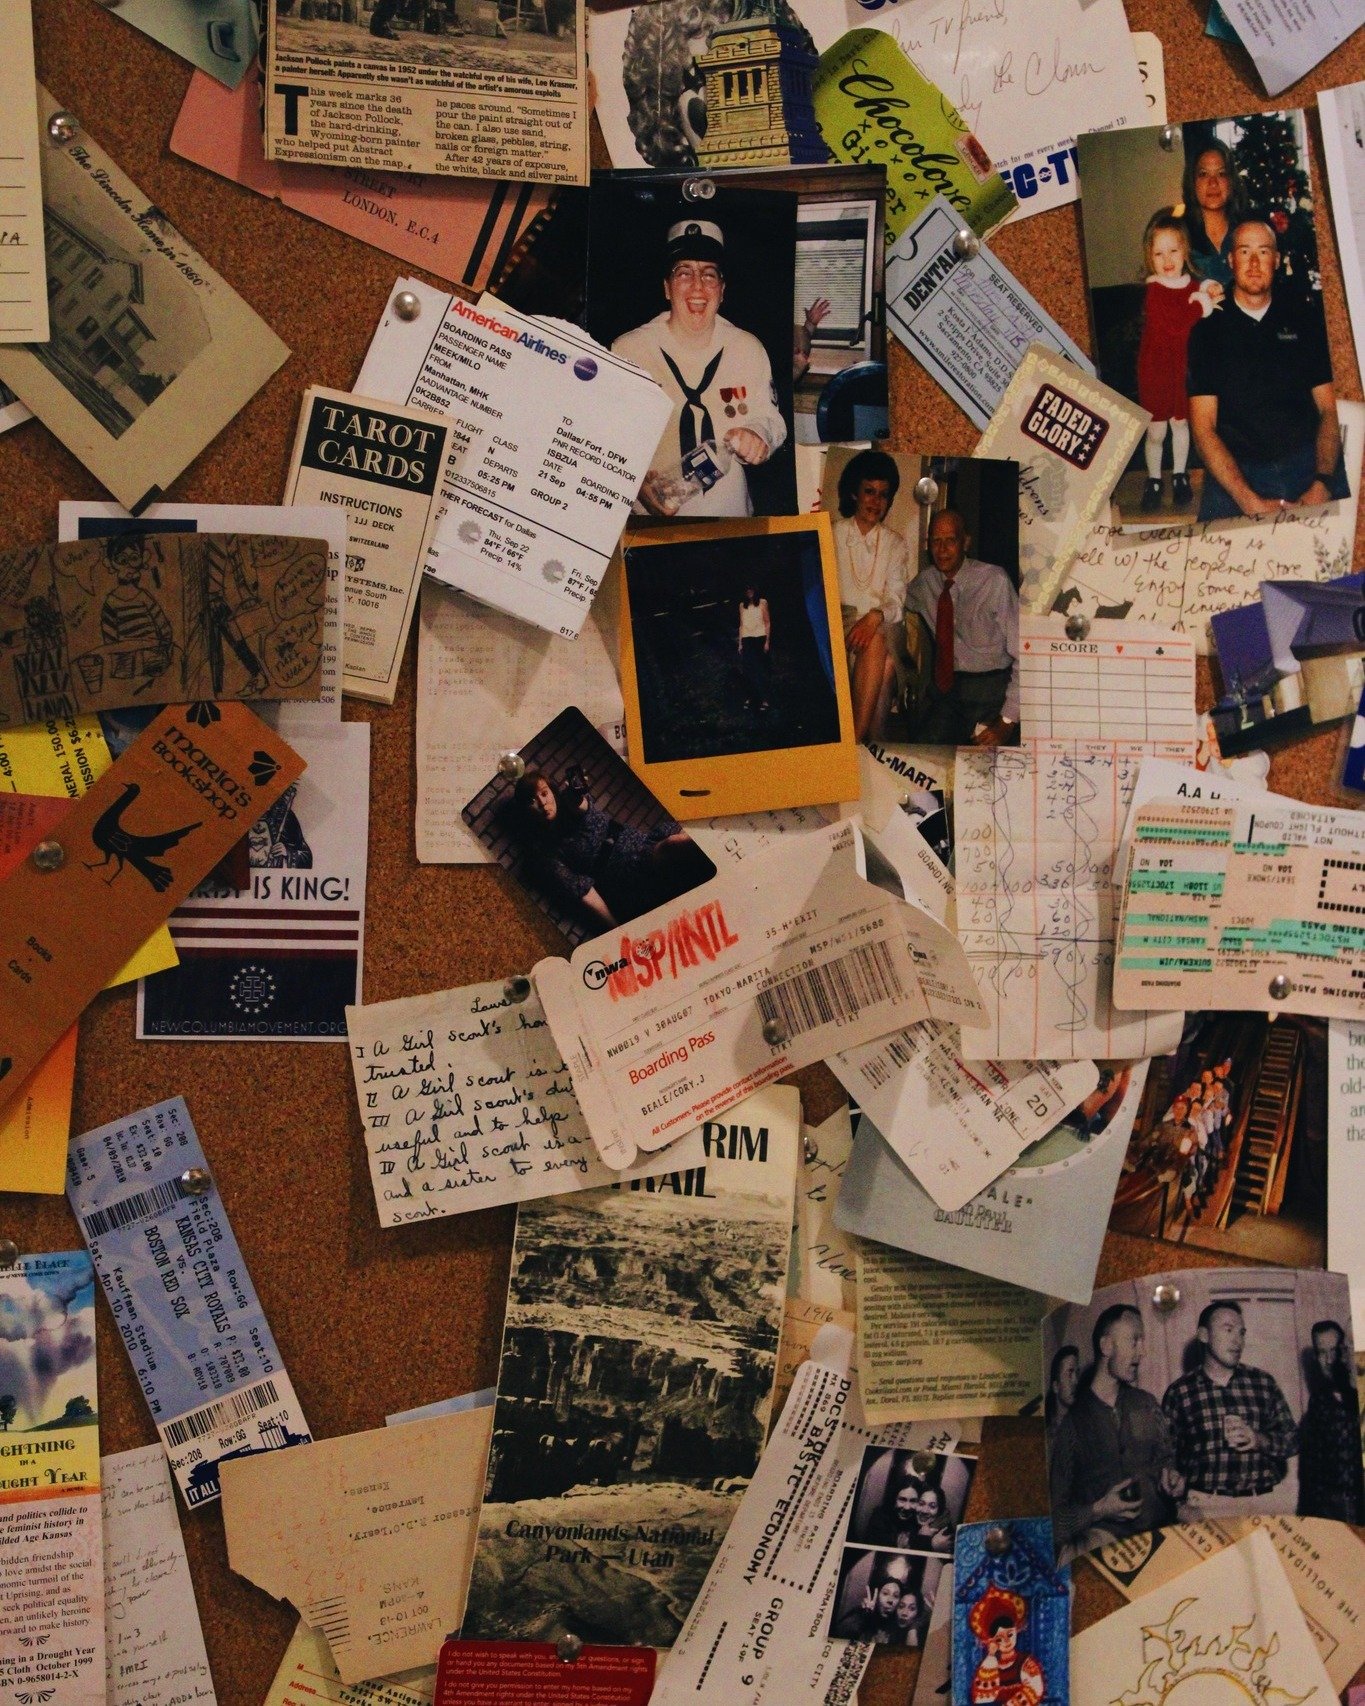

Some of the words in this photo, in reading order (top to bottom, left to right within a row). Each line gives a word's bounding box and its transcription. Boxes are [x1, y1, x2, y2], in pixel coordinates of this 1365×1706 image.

[310, 99, 337, 108] years
[329, 89, 352, 98] week
[356, 92, 387, 101] marks
[323, 110, 362, 121] Jackson
[365, 114, 403, 126] Pollock,
[506, 115, 543, 127] straight
[310, 130, 382, 144] Wyoming-born
[385, 136, 420, 148] painter
[435, 131, 468, 141] broken
[502, 138, 537, 148] pebbles,
[839, 58, 971, 213] Chocolove
[275, 147, 346, 162] Expressionism
[352, 145, 393, 156] Abstract
[525, 160, 568, 171] exposure,
[903, 247, 963, 312] DENTAL
[989, 274, 1007, 293] SEAT
[1006, 293, 1043, 333] RESERVED
[941, 314, 965, 341] Scripps
[947, 306, 966, 327] Kosta
[438, 333, 484, 359] PASSENGER
[486, 355, 507, 369] NAME
[442, 321, 488, 348] BOARDING
[489, 344, 512, 359] PASS
[433, 344, 481, 370] MEEK/MILO
[423, 365, 468, 391] Manhattan,
[419, 376, 469, 402] AADVANTAGE
[470, 399, 502, 418] NUMBER
[1038, 390, 1093, 436] FADED
[318, 405, 436, 454] TAROT
[456, 419, 482, 435] FLIGHT
[492, 435, 518, 451] CLASS
[1028, 414, 1082, 456] GLORY
[315, 437, 427, 484] CARDS
[483, 457, 518, 477] DEPARTS
[568, 445, 601, 465] RECORD
[602, 461, 636, 481] LOCATOR
[477, 469, 500, 484] 05:25
[580, 477, 619, 500] BOARDING
[319, 490, 403, 519] INSTRUCTIONS
[530, 487, 560, 506] GROUP
[575, 487, 598, 502] 04:55
[371, 520, 395, 532] DECK
[460, 499, 503, 523] FORECAST
[515, 524, 537, 539] Dallas
[348, 535, 389, 550] SWITZERLAND
[1050, 642, 1098, 653] SCORE
[916, 849, 954, 894] BOARDING
[254, 876, 271, 899] IS
[281, 877, 349, 900] KING!
[756, 958, 814, 990] CONNECTION
[151, 1021, 348, 1034] NEWCOLUMBIAMOVEMENT.ORG
[627, 1045, 689, 1085] Boarding
[687, 1029, 717, 1053] Pass
[1025, 1093, 1049, 1118] 2D
[454, 1116, 483, 1138] and
[704, 1122, 769, 1162] RIM
[188, 1201, 207, 1235] Field
[203, 1240, 221, 1272] Plaza
[144, 1226, 170, 1267] BOSTON
[161, 1270, 180, 1293] RED
[171, 1296, 189, 1318] SOX
[175, 1216, 201, 1257] KANSAS
[192, 1260, 213, 1288] CITY
[205, 1293, 231, 1332] ROYALS
[112, 1267, 139, 1320] Kauffman
[134, 1325, 158, 1370] Stadium
[226, 1269, 247, 1308] Row:GG
[248, 1327, 273, 1373] Seat:10
[120, 1324, 136, 1350] 2010
[137, 1368, 153, 1394] 6:10
[823, 1379, 851, 1429] DOCS
[199, 1479, 218, 1496] ALL
[817, 1469, 841, 1519] BOARDING
[7, 1523, 41, 1533] feminist
[44, 1519, 72, 1529] history
[16, 1512, 46, 1524] politics
[49, 1507, 77, 1517] collide
[42, 1531, 72, 1540] Kansas
[506, 1520, 629, 1542] Canyonlands
[631, 1528, 714, 1546] National
[742, 1497, 788, 1585] ECONOMY
[32, 1551, 74, 1561] friendship
[69, 1559, 92, 1569] social
[546, 1546, 592, 1564] Park
[628, 1549, 674, 1568] Utah
[61, 1606, 91, 1616] heroine
[747, 1611, 761, 1636] SEAT
[750, 1596, 784, 1660] GROUP
[7, 1666, 30, 1675] Cloth
[36, 1662, 70, 1671] October
[74, 1657, 93, 1666] 1999
[37, 1649, 73, 1660] Drought
[75, 1647, 95, 1655] Year
[18, 1670, 79, 1684] 0-9658014-2-X
[588, 1663, 630, 1672] Amendment
